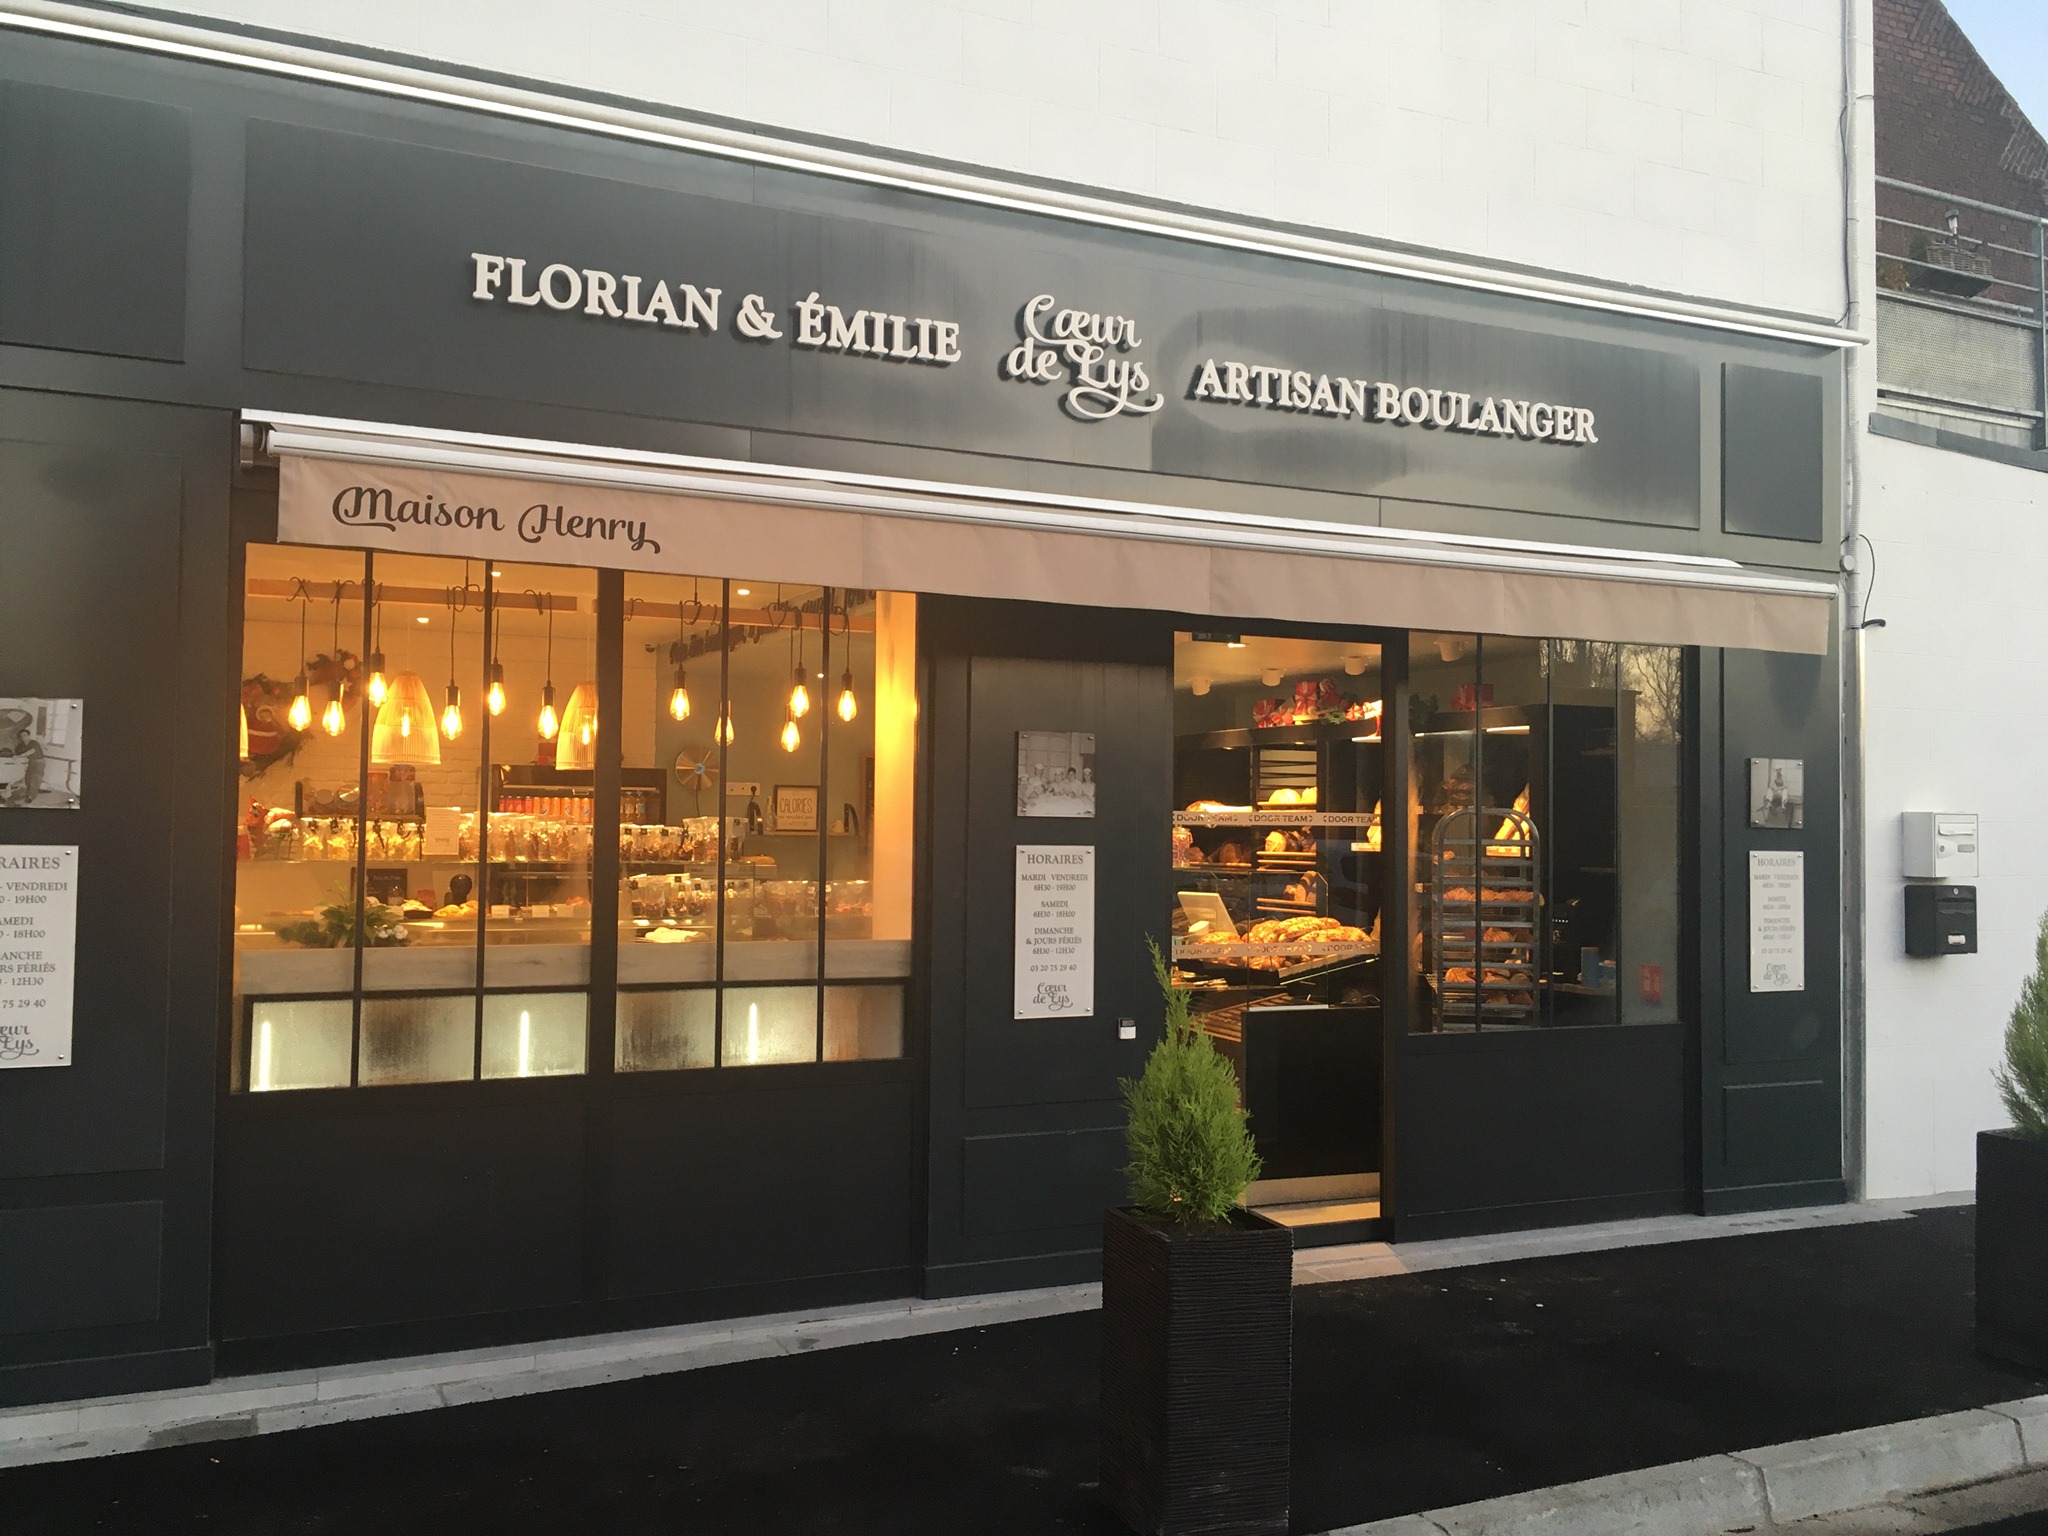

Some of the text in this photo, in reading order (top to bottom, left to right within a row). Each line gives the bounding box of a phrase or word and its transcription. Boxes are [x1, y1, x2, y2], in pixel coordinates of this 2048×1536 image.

[471, 252, 963, 363] FLORIAN & ÉMILIE
[1006, 336, 1165, 419] de Lys
[1195, 358, 1599, 444] ARTISAN BOULANGER
[332, 486, 661, 554] Maison Henry
[1282, 814, 1308, 823] TEAM
[1328, 815, 1354, 823] DOOR
[1027, 854, 1084, 864] HORAIRES
[1757, 858, 1796, 867] HORAIRES
[6, 881, 68, 892] VENDREDI
[15, 895, 47, 905] 19H00
[14, 929, 46, 939] 18H00
[1034, 937, 1057, 945] JOURS
[17, 962, 56, 973] FÉRIÉS
[12, 977, 44, 987] 12H30
[2, 999, 47, 1008] 75 29 40
[1033, 993, 1046, 1004] de
